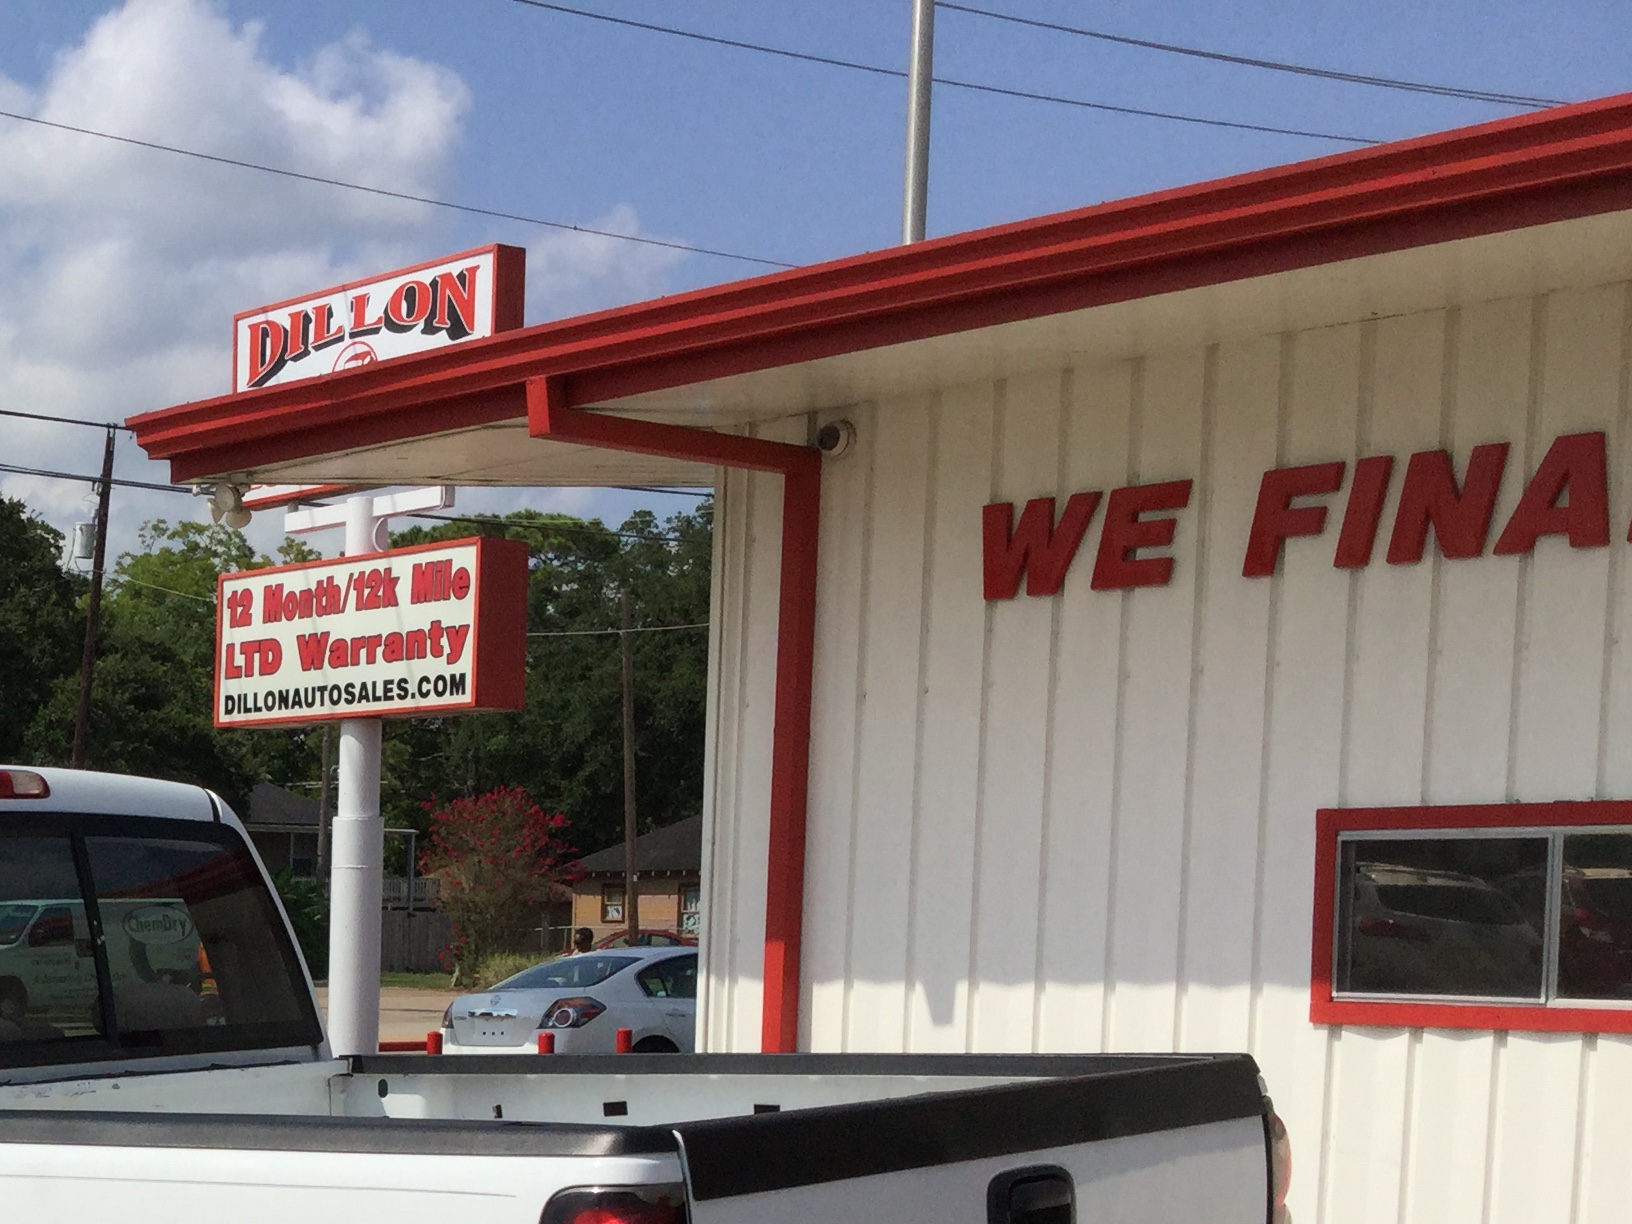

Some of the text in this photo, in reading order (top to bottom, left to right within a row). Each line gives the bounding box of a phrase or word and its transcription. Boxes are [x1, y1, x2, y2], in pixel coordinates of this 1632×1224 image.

[247, 264, 481, 388] DILLON
[983, 432, 1632, 600] WE FINA
[227, 588, 253, 628] 12
[411, 559, 470, 604] Mile
[225, 620, 470, 680] LTD Warranty
[224, 672, 467, 715] DILLONAUTOSALES.COM
